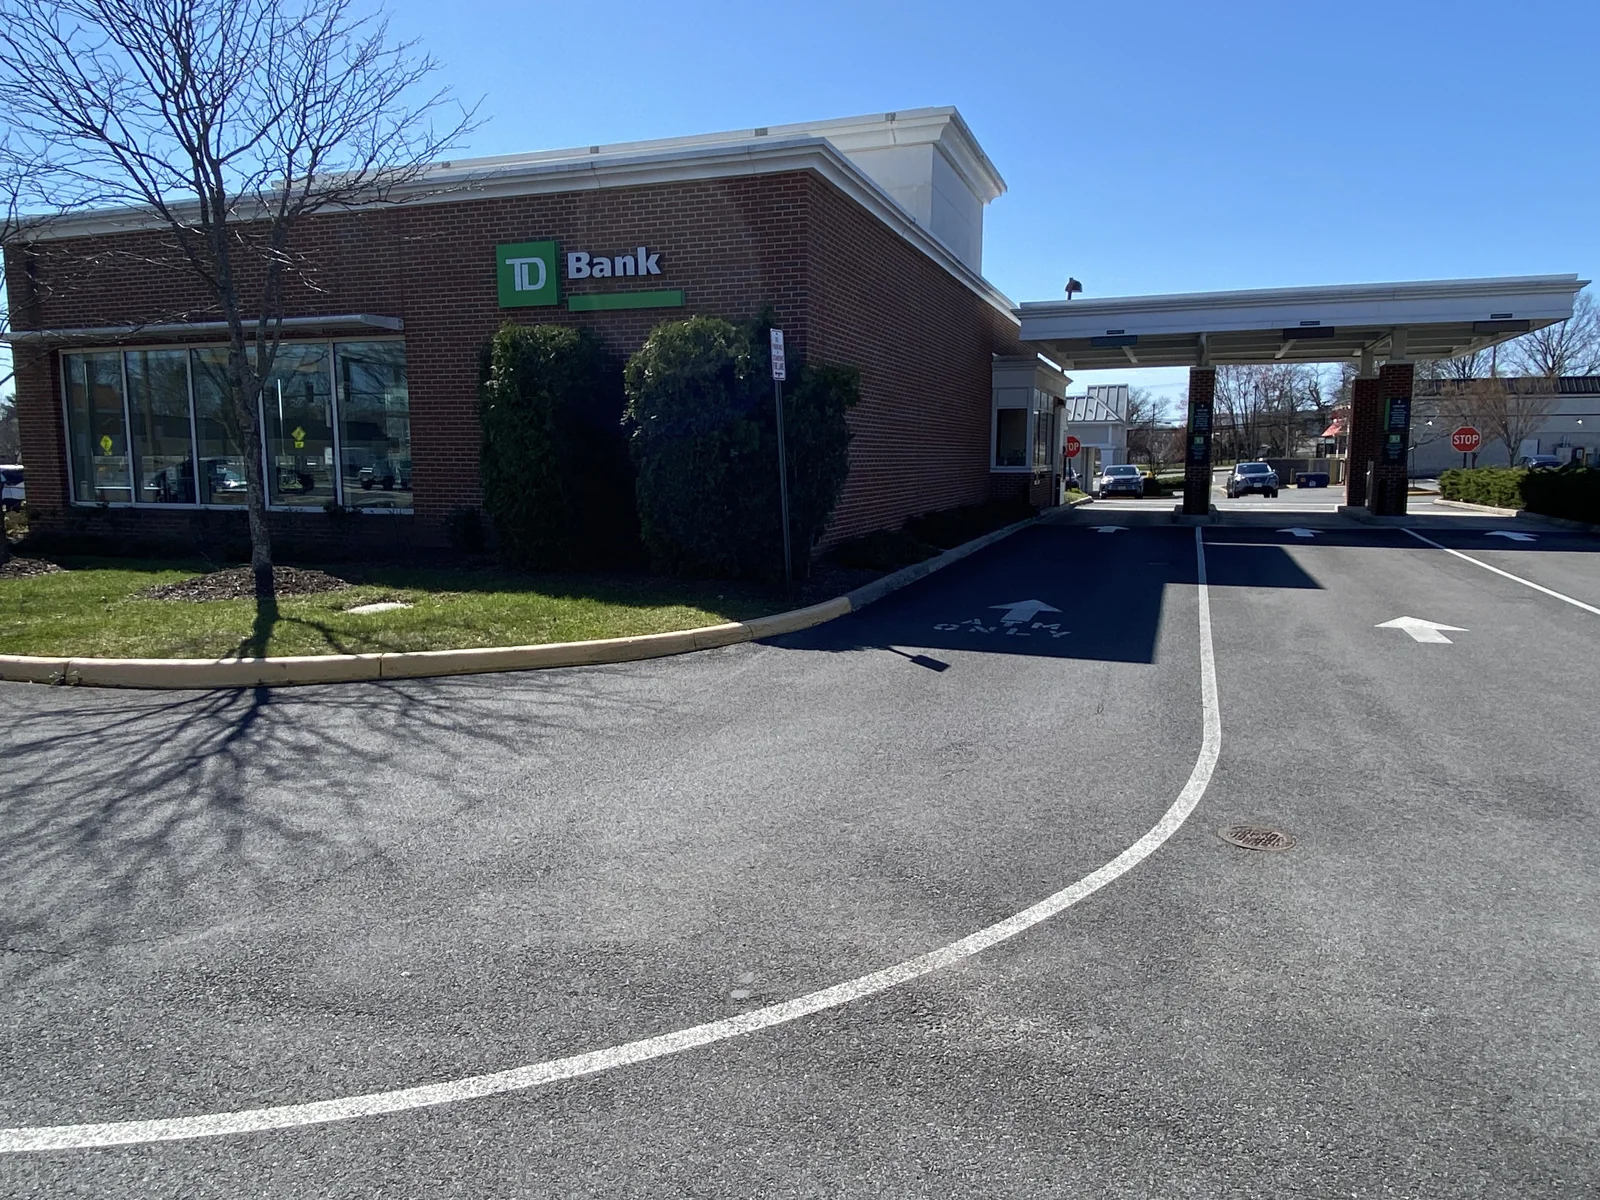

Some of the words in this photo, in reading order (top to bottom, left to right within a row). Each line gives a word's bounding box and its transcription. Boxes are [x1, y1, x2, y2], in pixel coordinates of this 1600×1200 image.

[505, 257, 547, 291] TD
[567, 246, 662, 279] Bank
[1453, 434, 1479, 445] STOP
[933, 623, 1072, 638] ONLY
